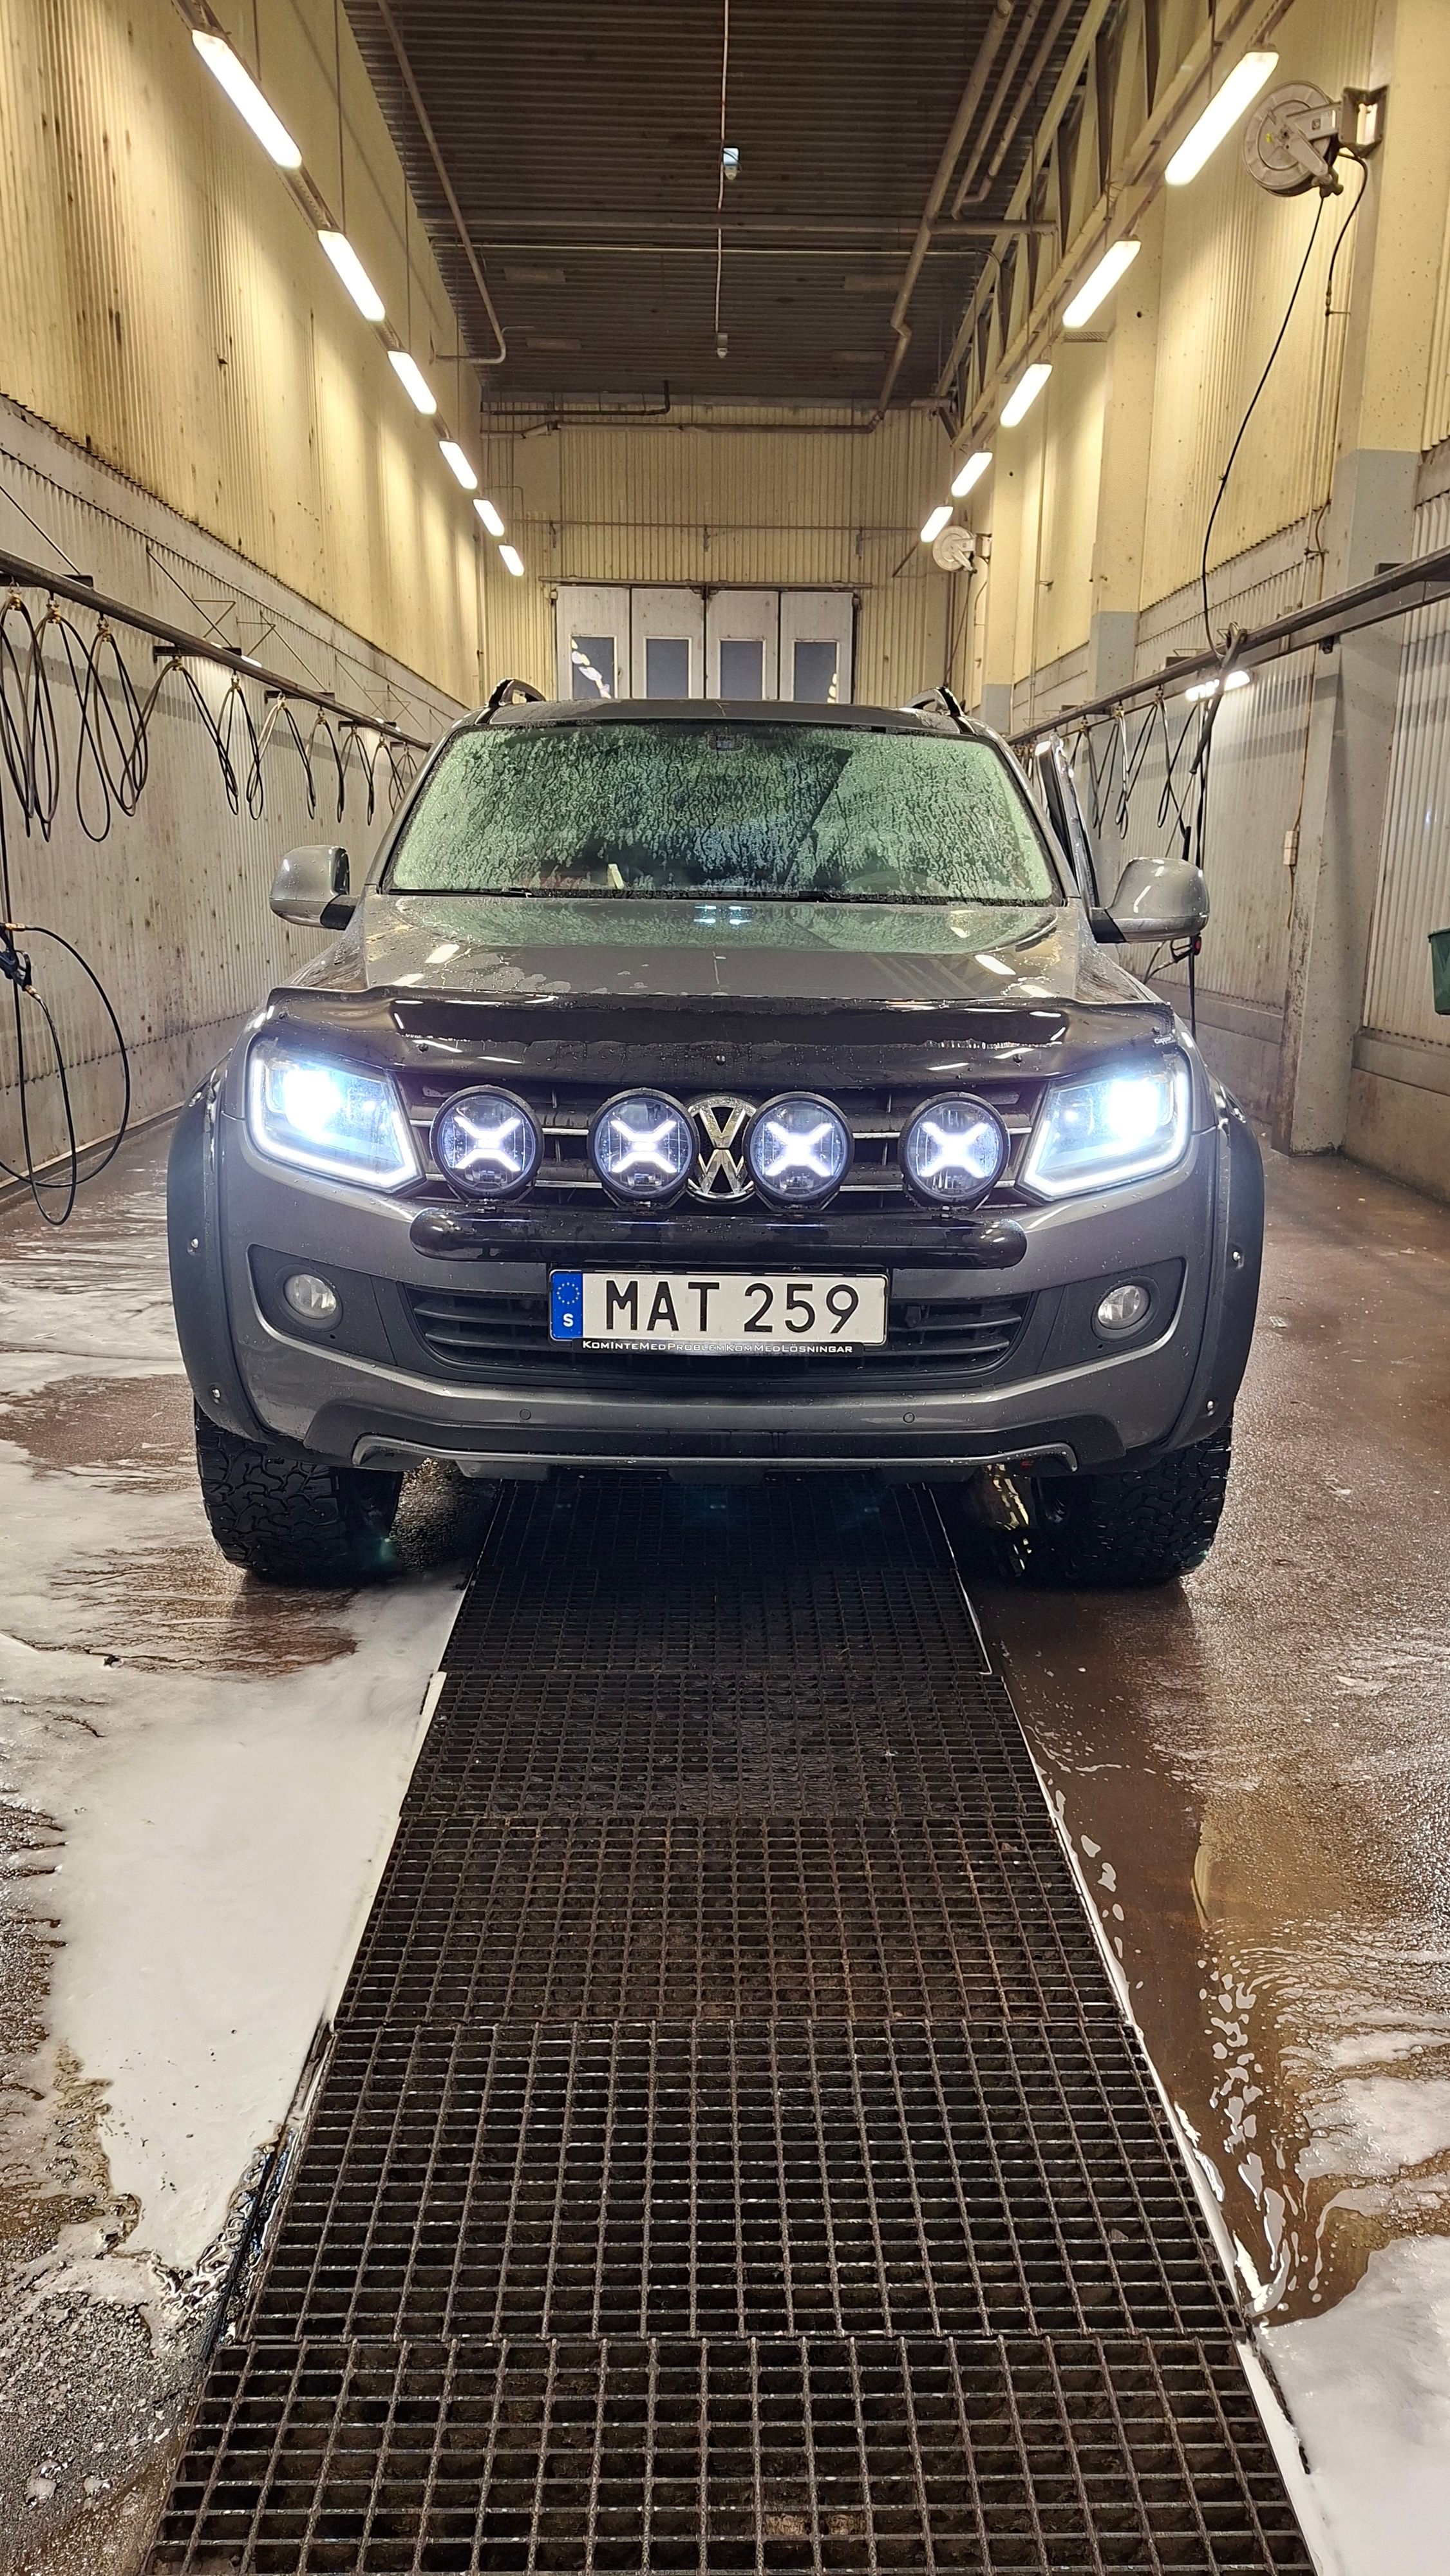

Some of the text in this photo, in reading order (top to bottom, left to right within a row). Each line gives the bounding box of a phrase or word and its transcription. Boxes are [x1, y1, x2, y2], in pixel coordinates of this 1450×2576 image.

[563, 1313, 574, 1328] S
[606, 1280, 859, 1334] MAT 259
